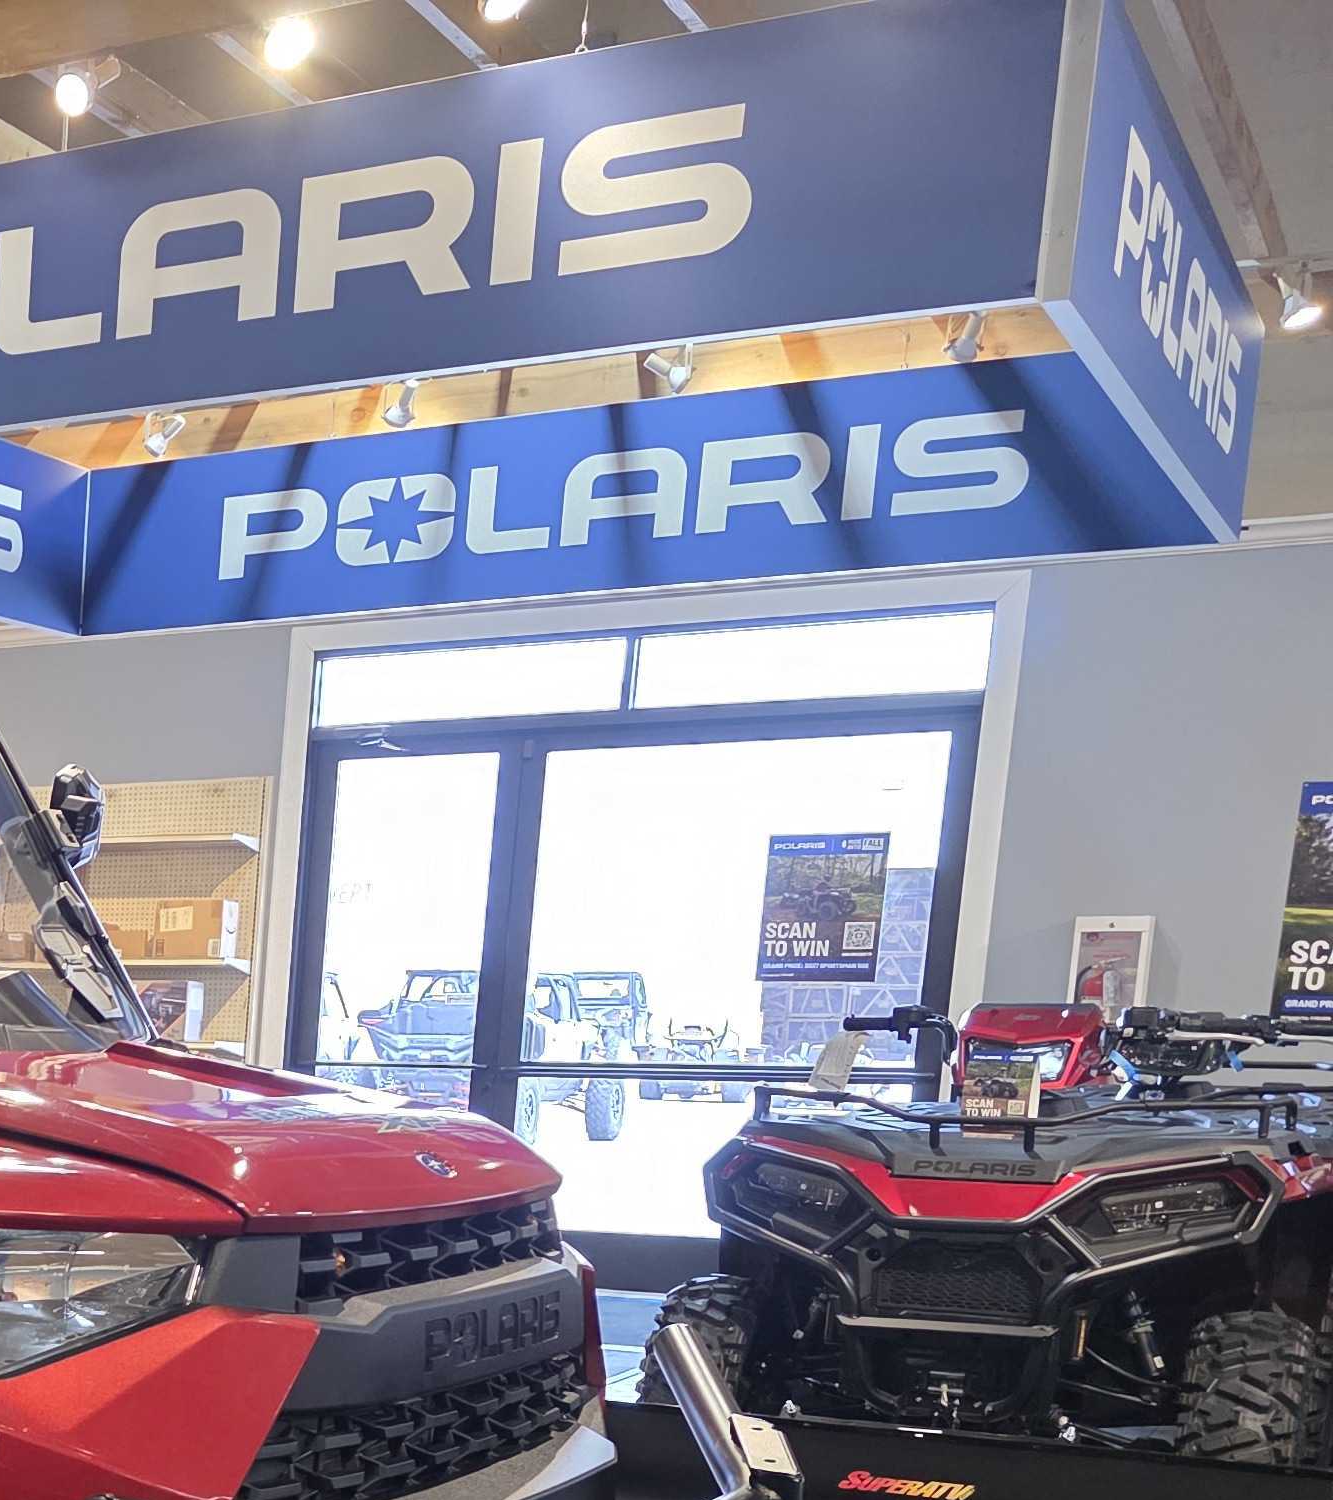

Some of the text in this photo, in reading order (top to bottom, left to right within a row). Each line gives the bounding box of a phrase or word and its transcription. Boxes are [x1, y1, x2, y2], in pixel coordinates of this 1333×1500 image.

[1114, 124, 1243, 455] POLARIS
[218, 409, 1031, 582] POLARIS
[773, 842, 826, 850] POLARIS
[764, 921, 817, 939] SCAN
[764, 939, 830, 957] TO WIN
[1289, 939, 1333, 966] SC
[1286, 966, 1326, 991] TO
[1284, 999, 1319, 1009] GRAND
[964, 1098, 994, 1108] SCAN
[964, 1108, 1002, 1117] TO WIN
[913, 1159, 1037, 1177] POLARIS
[423, 1290, 562, 1373] POLARIS
